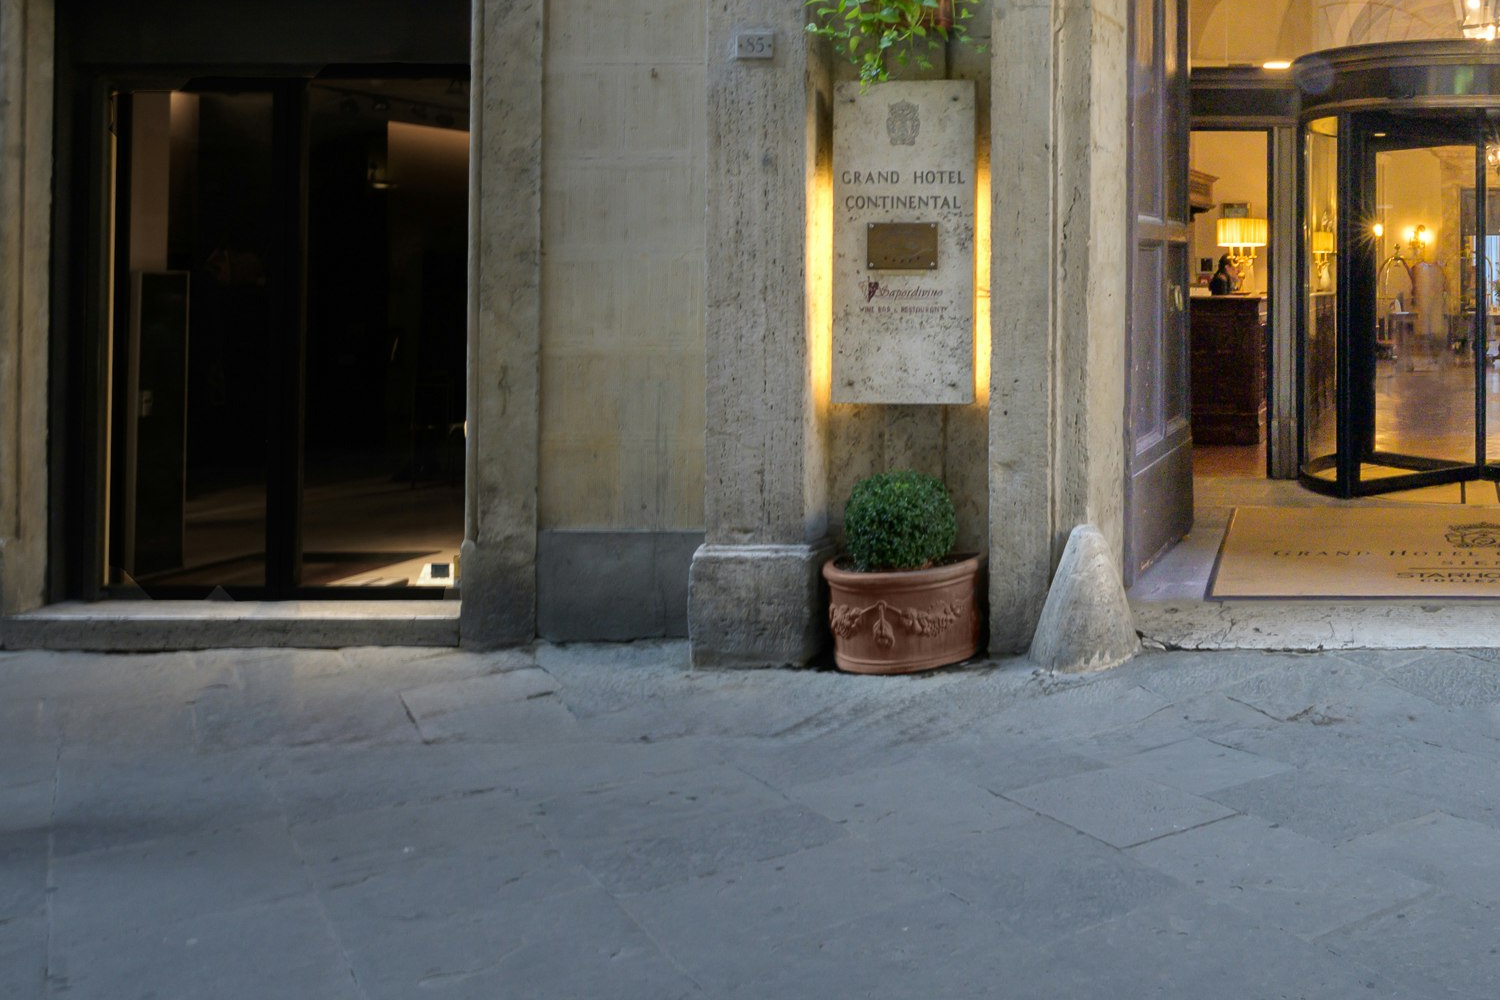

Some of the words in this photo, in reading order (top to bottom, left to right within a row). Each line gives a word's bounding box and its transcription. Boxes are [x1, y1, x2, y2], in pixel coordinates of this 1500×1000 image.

[841, 170, 901, 185] GRAND
[913, 170, 966, 185] HOTEL
[845, 195, 961, 210] CONTINENTAL
